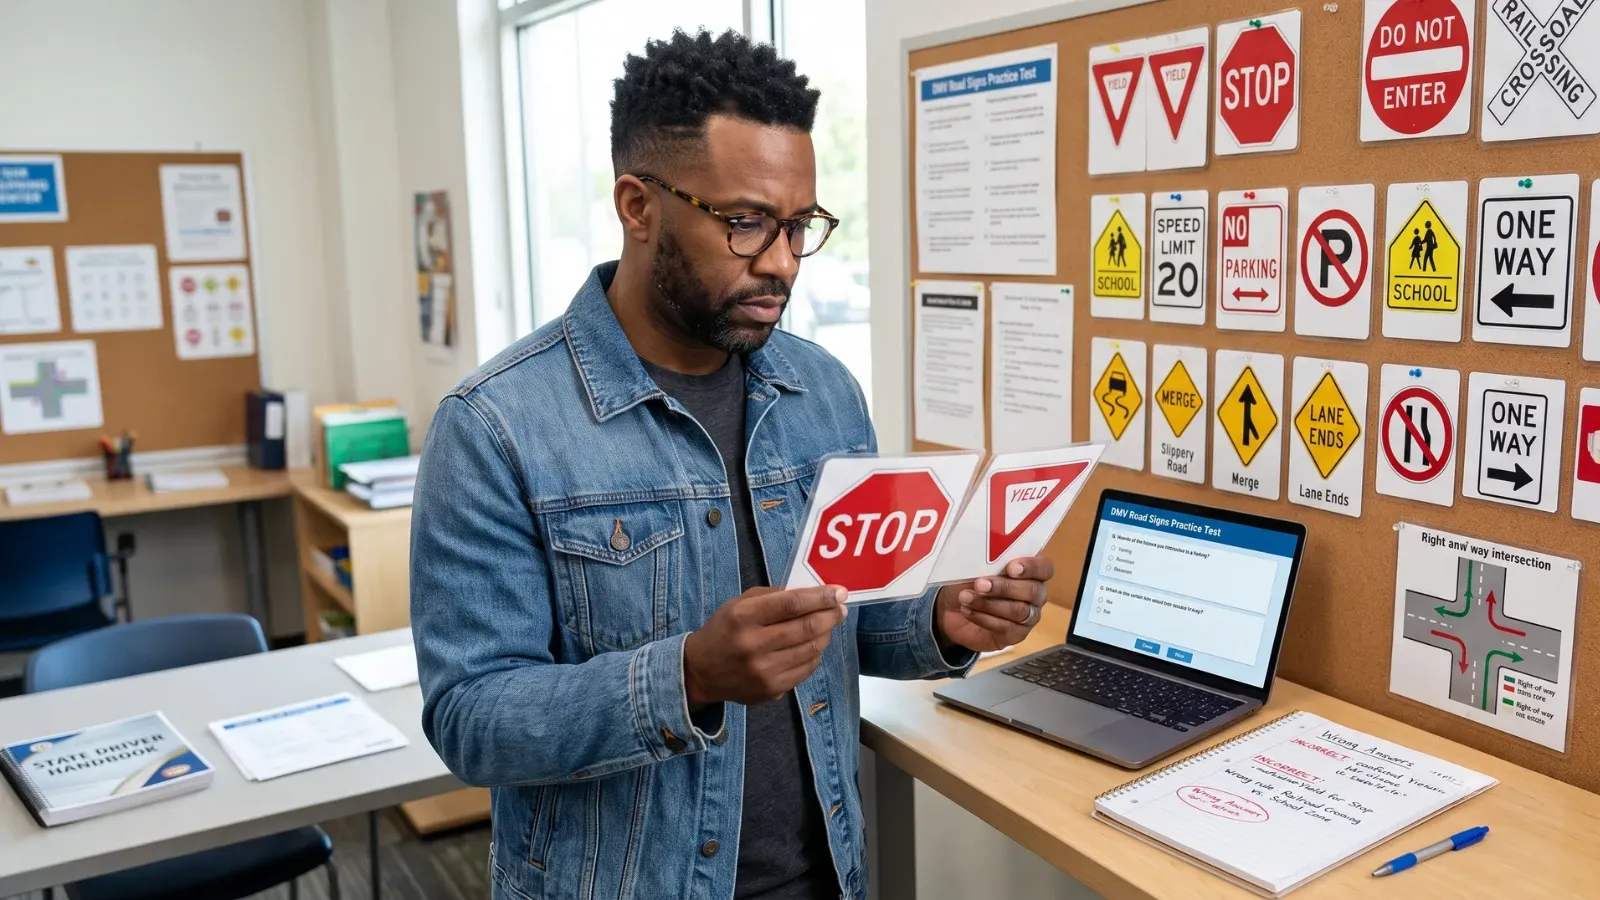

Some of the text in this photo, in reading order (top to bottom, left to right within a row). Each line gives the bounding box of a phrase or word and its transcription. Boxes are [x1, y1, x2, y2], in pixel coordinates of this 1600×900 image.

[1380, 16, 1456, 48] DO NOT
[988, 69, 1018, 86] Practice
[1019, 66, 1037, 80] Test
[1108, 76, 1127, 91] YIELD
[1165, 67, 1186, 83] YIELD
[1224, 61, 1291, 110] STOP
[1383, 81, 1446, 110] ENTER
[1157, 218, 1200, 233] SPEED
[1224, 215, 1247, 241] NO
[1496, 209, 1556, 239] ONE
[1161, 240, 1195, 255] LIMIT
[1225, 258, 1277, 279] PARKING
[1493, 247, 1556, 276] WAY
[1097, 276, 1137, 291] SCHOOL
[1157, 262, 1198, 298] 20
[1393, 283, 1452, 303] SCHOOL
[1162, 390, 1196, 409] MERGE
[1310, 404, 1344, 425] LANE
[1491, 401, 1537, 428] ONE
[1309, 428, 1344, 449] ENDS
[1489, 429, 1537, 457] WAY
[1161, 443, 1194, 462] Slippery
[1167, 459, 1188, 474] Road
[1231, 472, 1260, 490] Merge
[1009, 485, 1048, 503] YIELD
[1299, 484, 1349, 506] Lane Ends
[1110, 507, 1222, 537] DMV Road Signs Practice Test
[818, 508, 938, 560] STOP
[1421, 532, 1446, 547] Right
[1470, 545, 1490, 559] way
[1491, 547, 1551, 571] intersection
[1543, 688, 1556, 697] way
[1541, 710, 1554, 720] way
[1321, 730, 1359, 750] Wrong
[32, 733, 165, 769] STATE DRIVER
[47, 745, 159, 776] HANDBOOK
[1225, 768, 1253, 784] Wrong
[1281, 790, 1326, 809] Railroad
[1269, 795, 1304, 812] School
[1304, 810, 1332, 823] Zone
[1348, 801, 1374, 813] Stop
